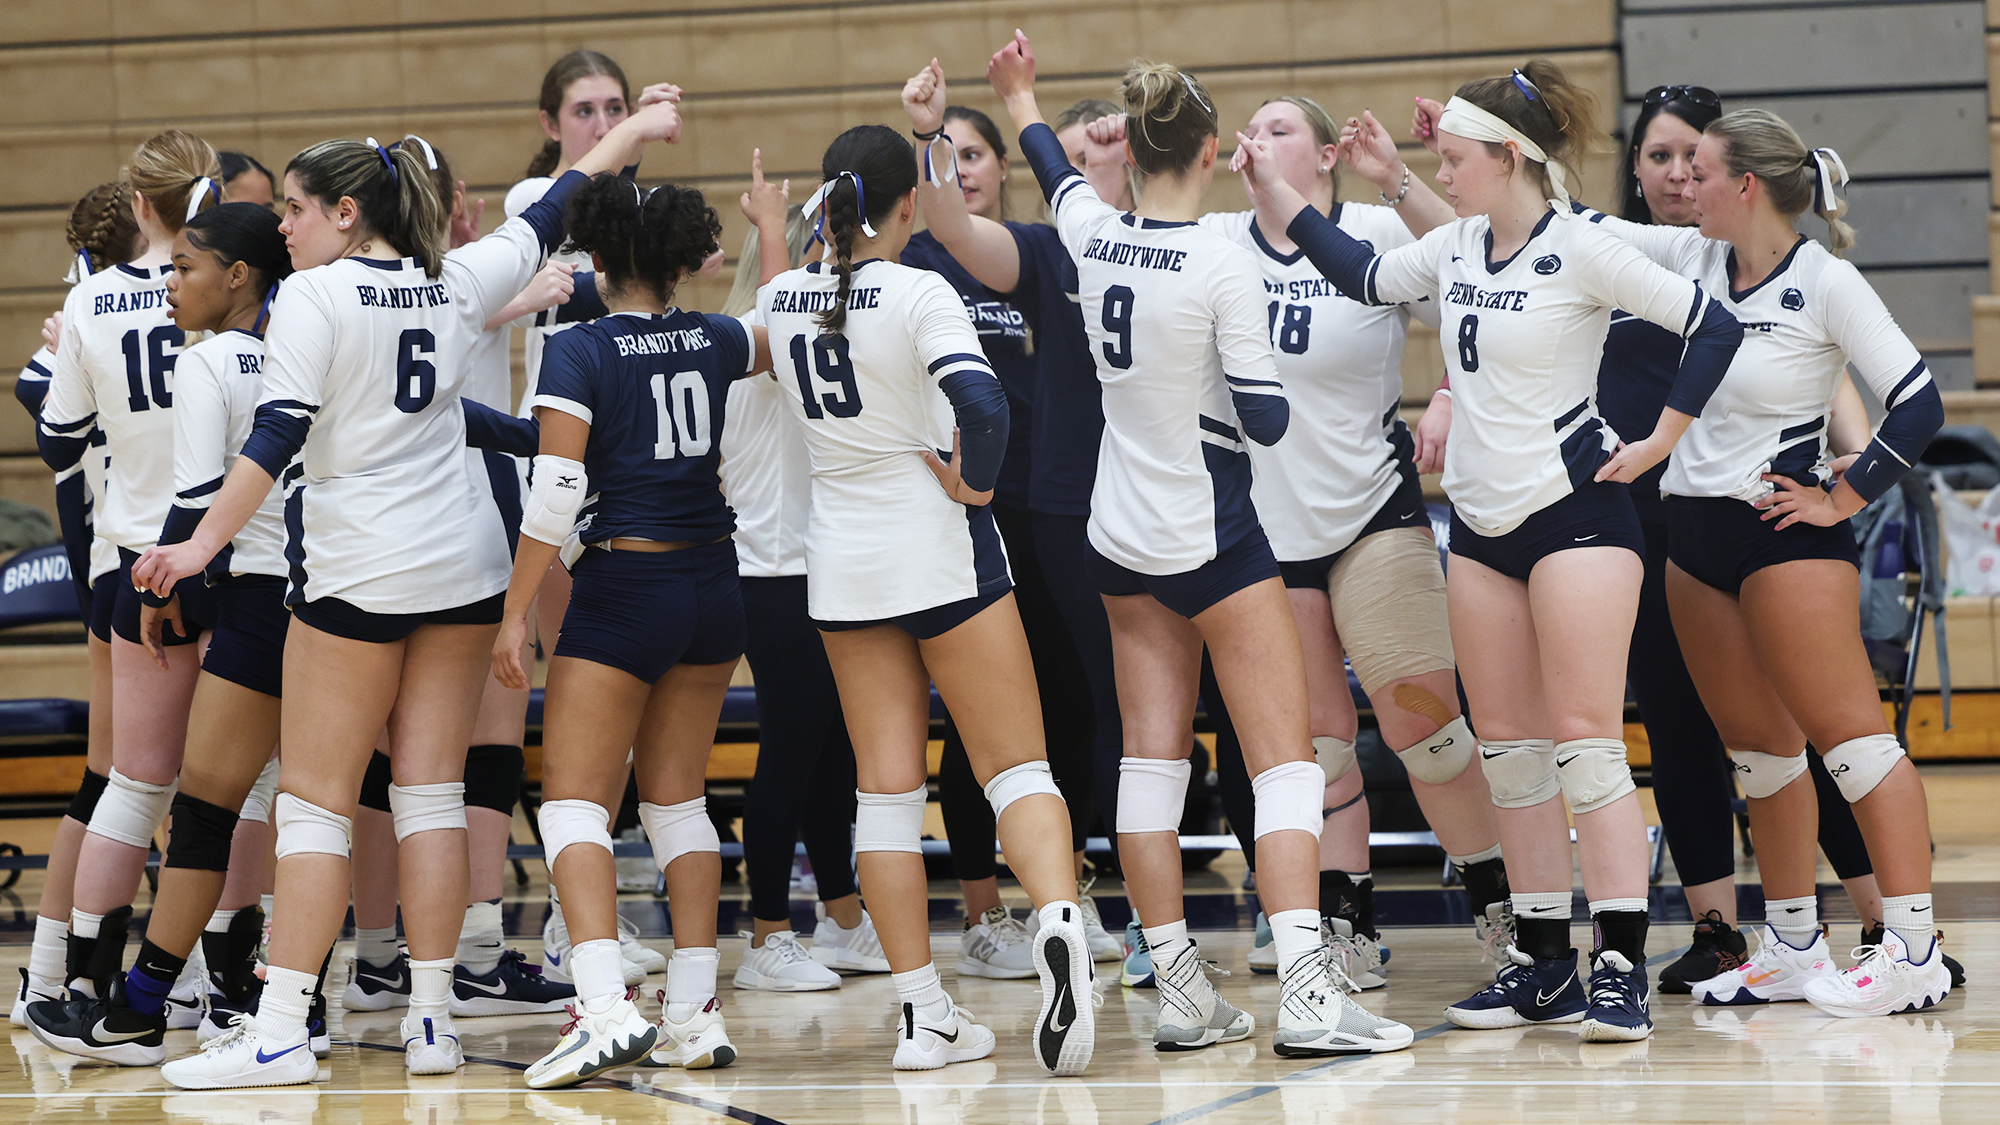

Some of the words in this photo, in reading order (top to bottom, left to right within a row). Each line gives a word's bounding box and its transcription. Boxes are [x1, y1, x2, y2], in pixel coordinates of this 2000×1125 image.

[94, 288, 171, 315] BRANDY
[771, 287, 881, 313] BRANDYINE
[1101, 284, 1135, 370] 9
[1445, 281, 1477, 306] PENN
[1476, 289, 1528, 311] STATE
[121, 325, 185, 412] 16
[236, 353, 265, 374] BR
[394, 328, 435, 413] 6
[790, 333, 863, 419] 19
[1458, 313, 1479, 372] 8
[650, 371, 711, 460] 10
